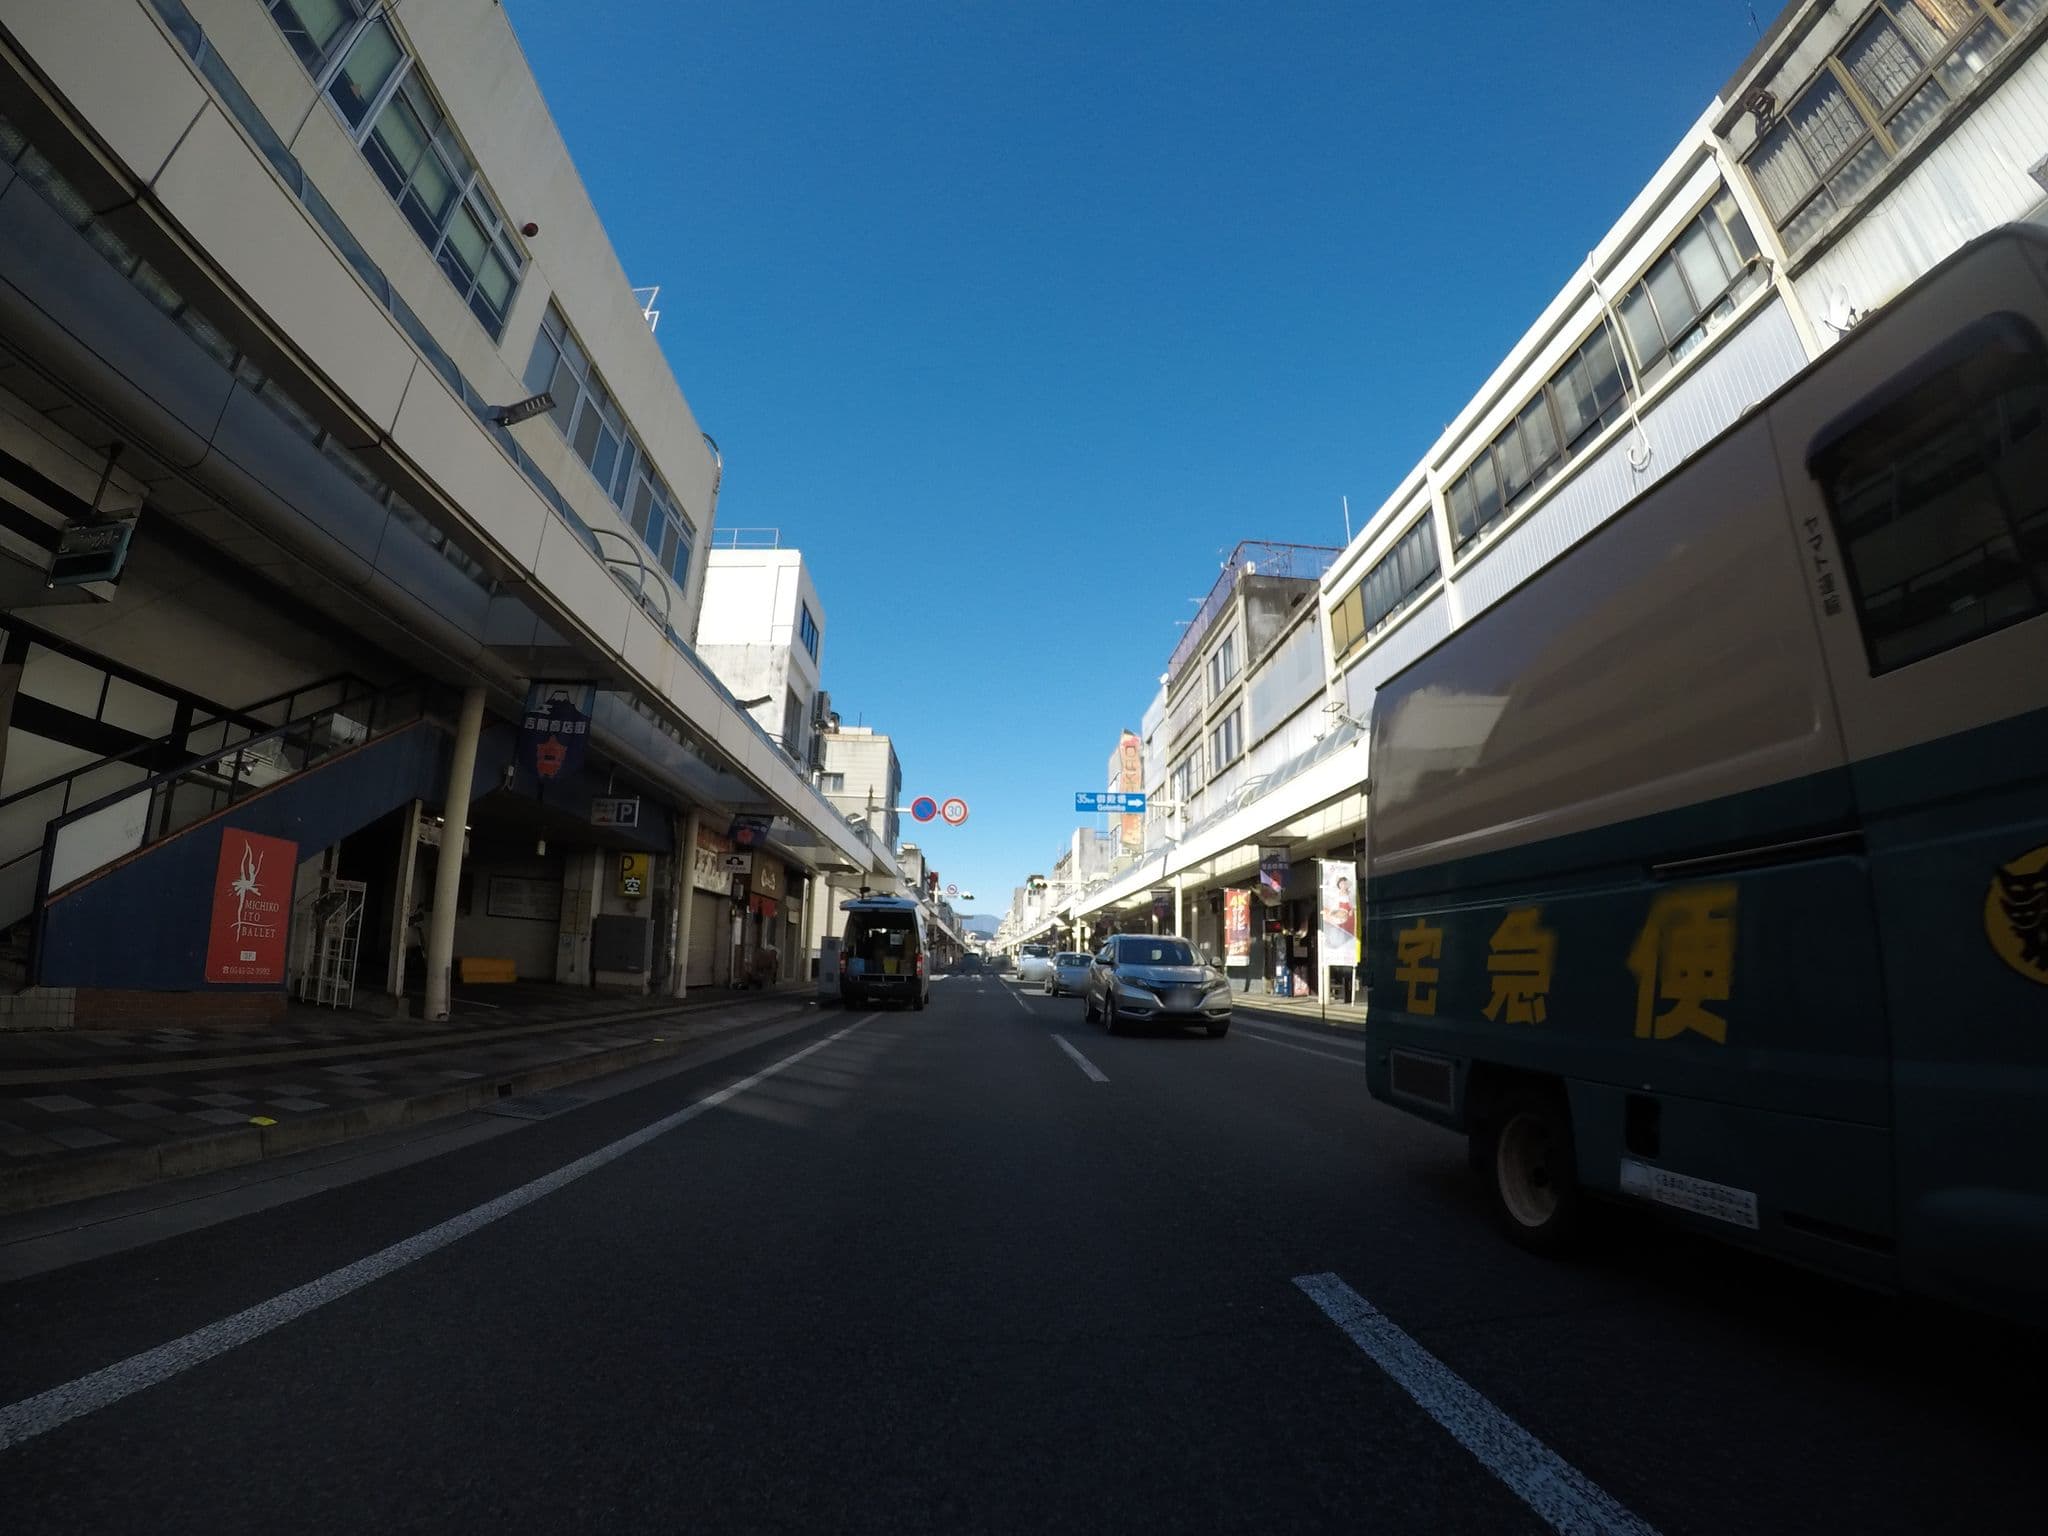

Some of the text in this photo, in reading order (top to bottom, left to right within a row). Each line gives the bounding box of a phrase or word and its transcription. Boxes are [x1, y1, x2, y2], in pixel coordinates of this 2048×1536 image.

[620, 804, 633, 822] P
[947, 805, 962, 817] 30
[620, 855, 635, 882] P
[624, 876, 641, 895] 空
[244, 899, 280, 913] MICHIKO
[243, 911, 261, 922] ITO
[240, 926, 277, 939] BALLET
[1394, 884, 1738, 1046] 宅急便
